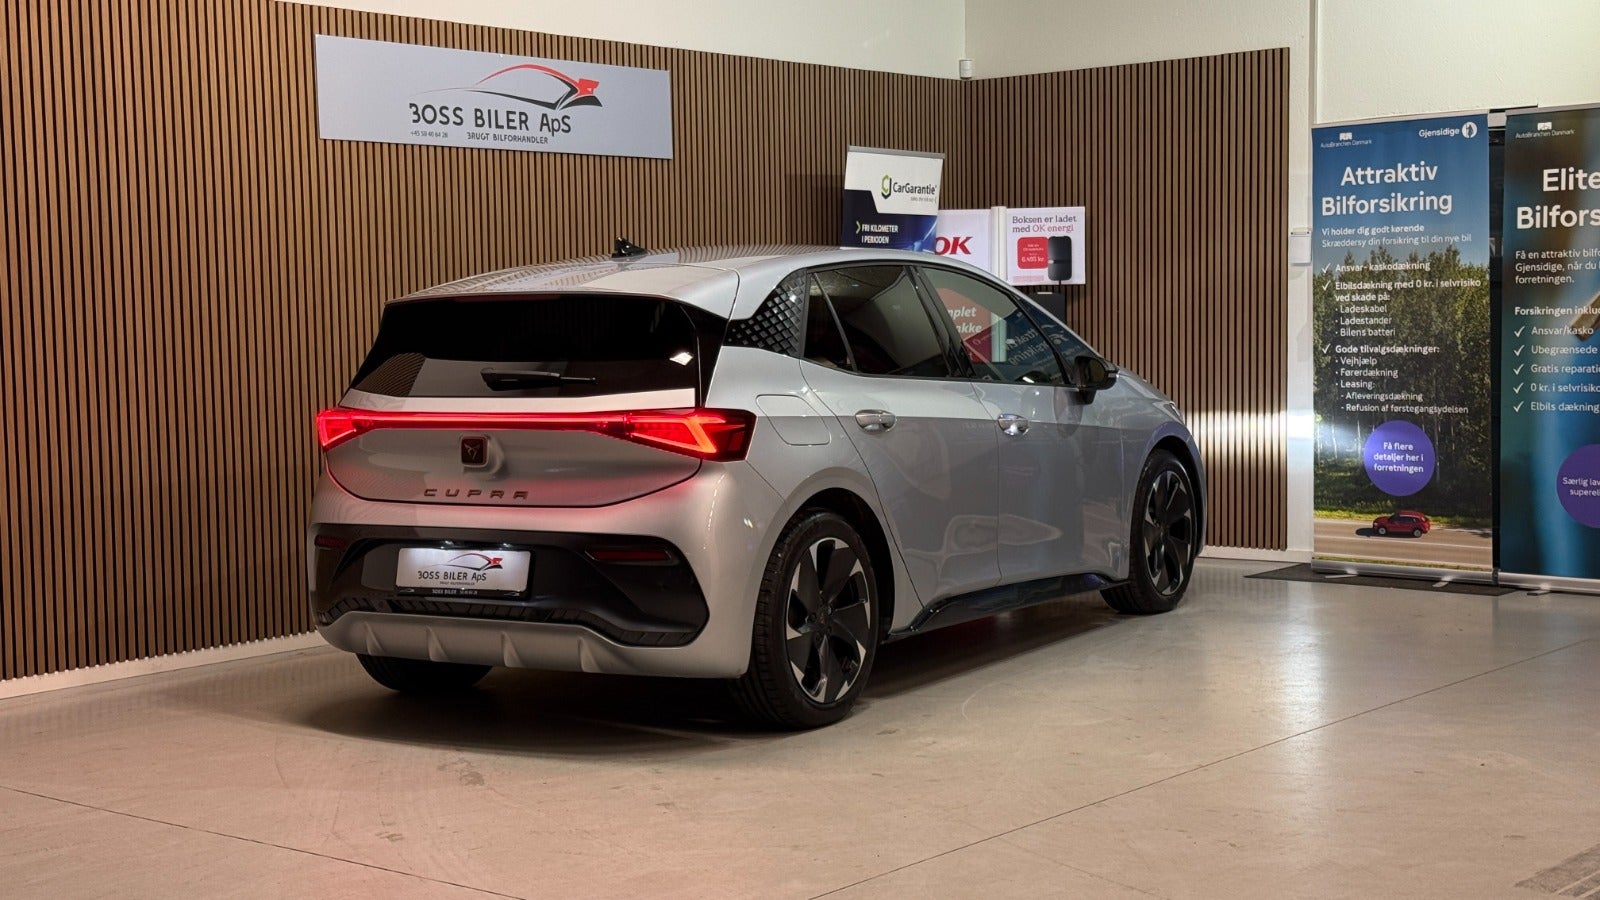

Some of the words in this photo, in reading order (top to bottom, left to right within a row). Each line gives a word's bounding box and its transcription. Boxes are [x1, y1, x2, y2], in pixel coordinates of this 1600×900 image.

[474, 108, 529, 131] BILER
[540, 113, 571, 137] ApS
[1419, 127, 1459, 138] Gjensidige
[493, 133, 548, 144] BILFORHANDLER
[1340, 161, 1438, 186] Attraktiv
[1543, 167, 1600, 192] Elite
[893, 181, 936, 195] CarGarantie
[1322, 191, 1452, 216] Bilforsikring
[1012, 215, 1043, 225] Boksen
[1055, 215, 1076, 224] ladet
[1517, 205, 1600, 229] Bilfors
[871, 224, 898, 233] KILOMETER
[1012, 225, 1030, 233] med
[1032, 224, 1046, 233] OK
[1047, 225, 1074, 233] energi
[1322, 228, 1330, 236] Vi
[1331, 226, 1355, 235] holder
[1357, 226, 1369, 235] dig
[1371, 226, 1390, 235] godt
[1391, 224, 1424, 233] kørende
[935, 236, 973, 256] OK
[1322, 238, 1366, 248] Skræddersy
[1382, 236, 1419, 245] forsikring
[1421, 235, 1429, 243] til
[1431, 235, 1443, 243] din
[1445, 237, 1460, 245] nye
[1462, 234, 1472, 242] bil
[1515, 251, 1526, 259] Få
[1541, 249, 1581, 259] attraktiv
[1335, 263, 1368, 272] Ansvar-
[1369, 262, 1430, 272] kaskodækning
[1515, 262, 1565, 272] Gjensidige,
[1568, 262, 1582, 270] når
[1585, 262, 1595, 270] du
[1335, 280, 1393, 290] Elbilsdækning
[1395, 281, 1414, 289] med
[1416, 280, 1421, 288] 0
[1423, 279, 1434, 288] kr.
[1440, 279, 1481, 288] selvrisiko
[1515, 275, 1574, 285] forretningen.
[1336, 293, 1350, 302] ved
[1352, 292, 1376, 301] skade
[1378, 292, 1390, 303] på:
[1340, 305, 1387, 314] Ladeskabel
[1515, 306, 1572, 317] Forsikringen
[1340, 317, 1392, 325] Ladestander
[1340, 328, 1366, 337] Bilens
[1368, 328, 1395, 336] batteri
[1532, 326, 1594, 337] Ansvar/kasko
[1335, 345, 1358, 353] Gode
[1360, 345, 1440, 354] tilvalgsdækninger:
[1531, 345, 1598, 355] Ubegrænsede
[1340, 357, 1378, 366] Vejhjælp
[1340, 368, 1398, 378] Førerdækning
[1531, 364, 1559, 373] Gratis
[1531, 383, 1536, 392] 0
[1539, 383, 1550, 392] kr.
[1346, 392, 1423, 402] Afleveringsdækning
[1346, 403, 1380, 412] Refusion
[1381, 404, 1389, 412] af
[1391, 404, 1469, 415] førstegangsydelsen
[1531, 401, 1555, 411] Elbils
[1558, 402, 1599, 413] dækning
[1383, 442, 1393, 450] Få
[1395, 442, 1413, 450] flere
[1373, 453, 1404, 462] detaljer
[1374, 464, 1424, 473] forretningen
[1563, 477, 1588, 487] Særlig
[424, 488, 529, 500] CUPRA
[444, 572, 468, 581] BILER
[472, 572, 487, 582] ApS
